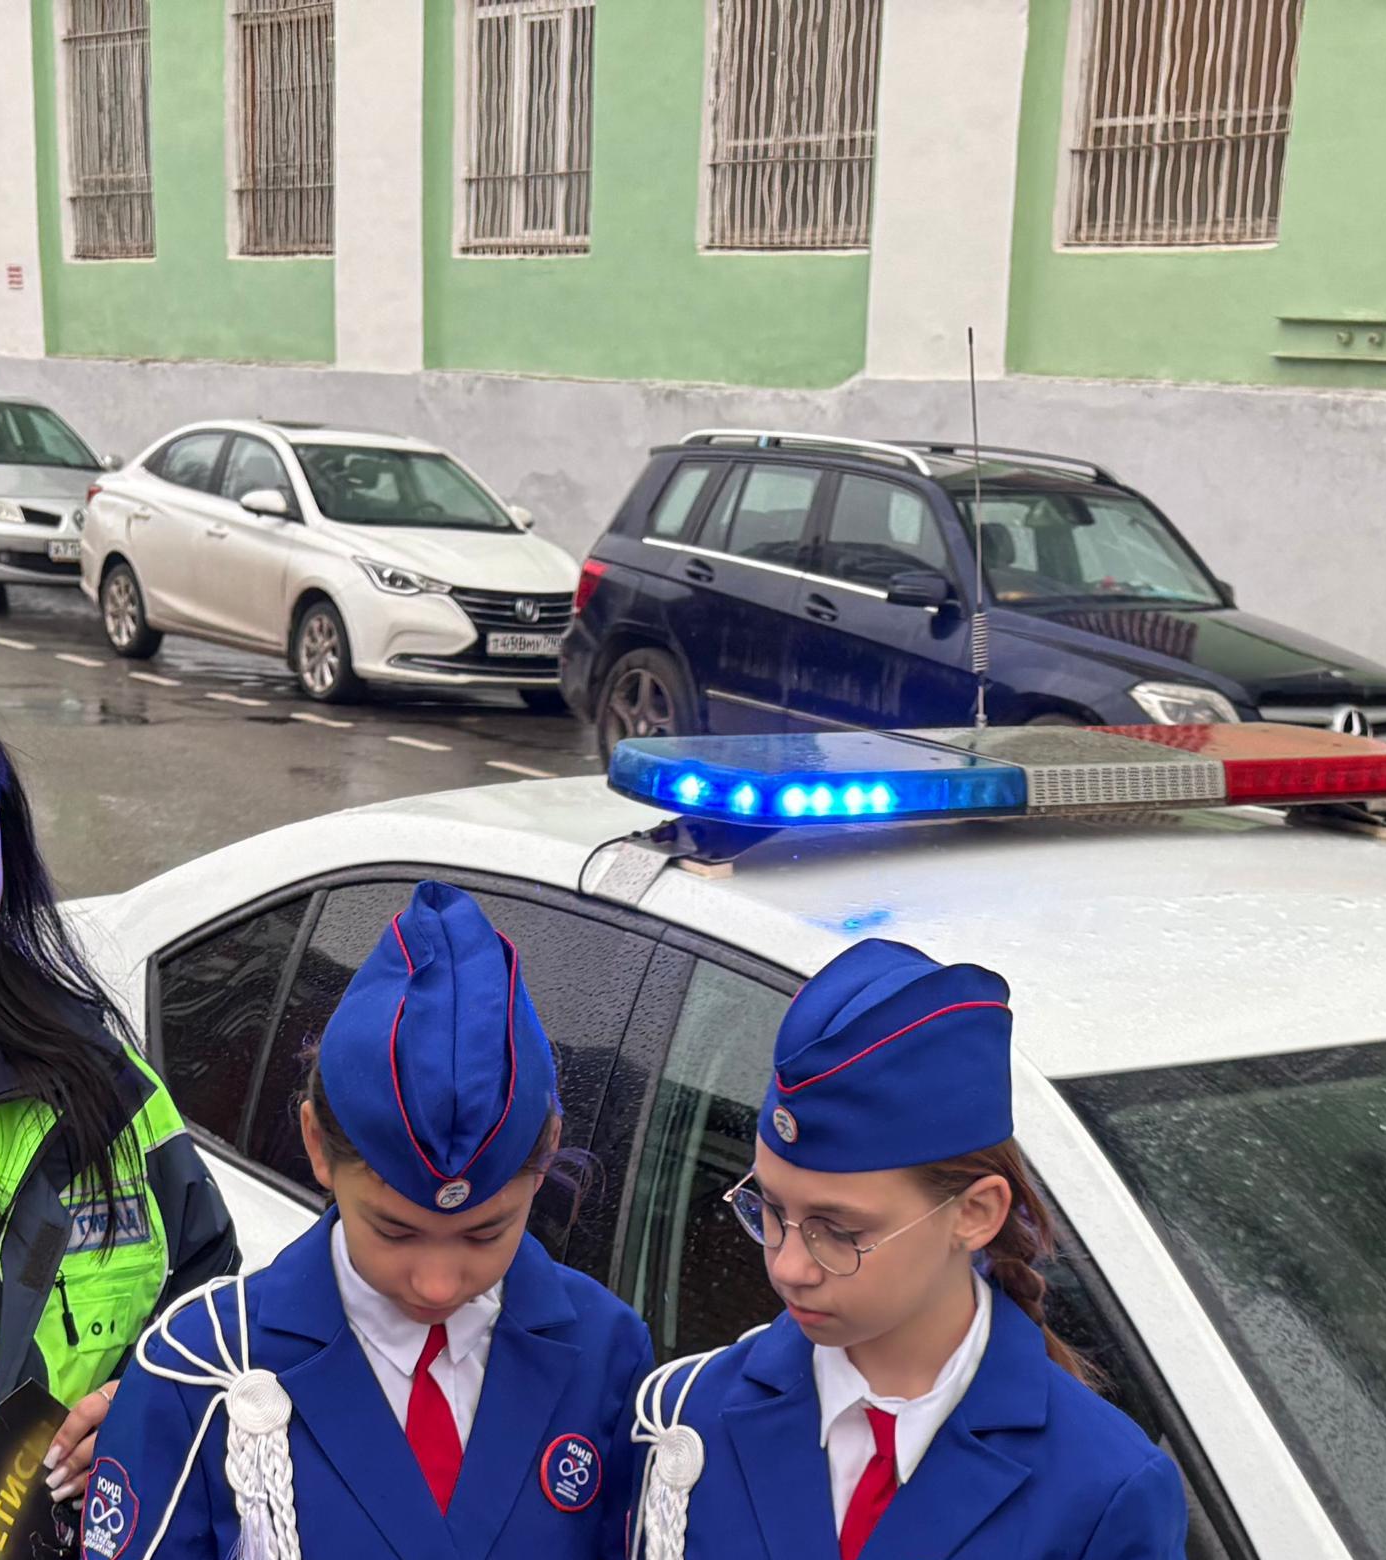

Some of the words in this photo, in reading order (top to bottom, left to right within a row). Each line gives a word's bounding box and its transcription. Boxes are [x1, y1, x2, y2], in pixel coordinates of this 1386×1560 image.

[76, 1208, 140, 1235] ГИДД
[567, 1441, 593, 1465] ЮИД
[97, 1476, 121, 1503] ЮИД
